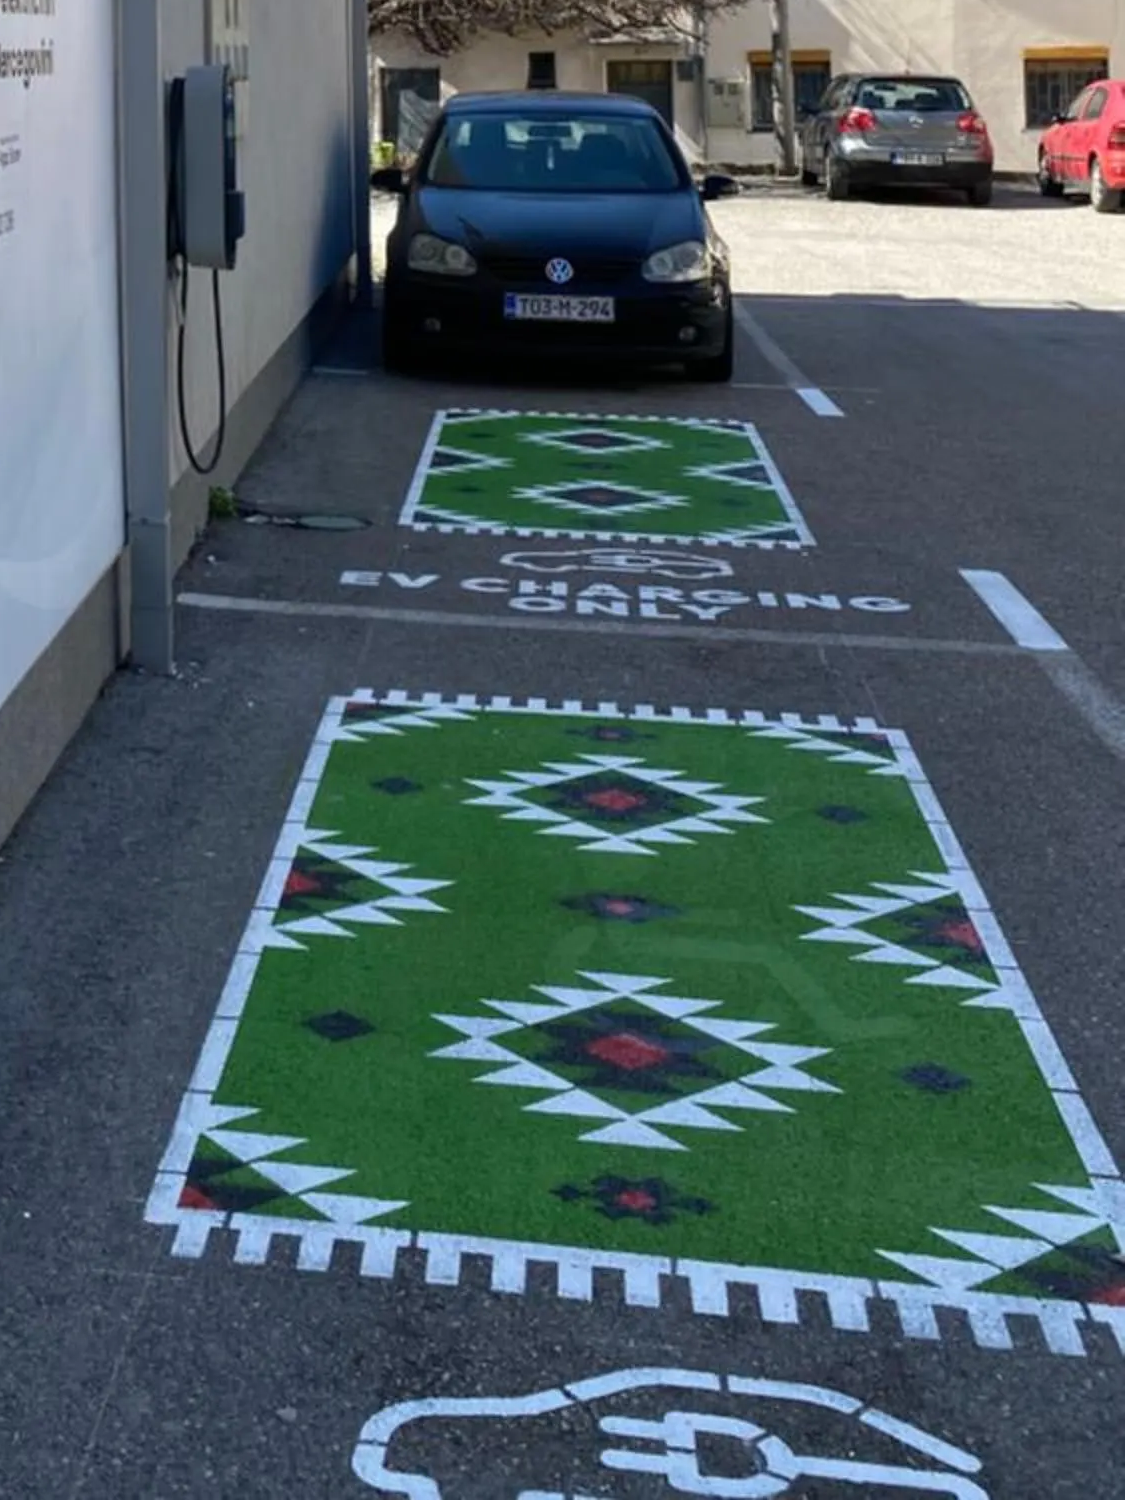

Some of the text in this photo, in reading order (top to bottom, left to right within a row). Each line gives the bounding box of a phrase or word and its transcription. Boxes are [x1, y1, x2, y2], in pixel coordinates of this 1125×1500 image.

[339, 570, 912, 613] EV CHARGING
[508, 596, 733, 621] ONLY
